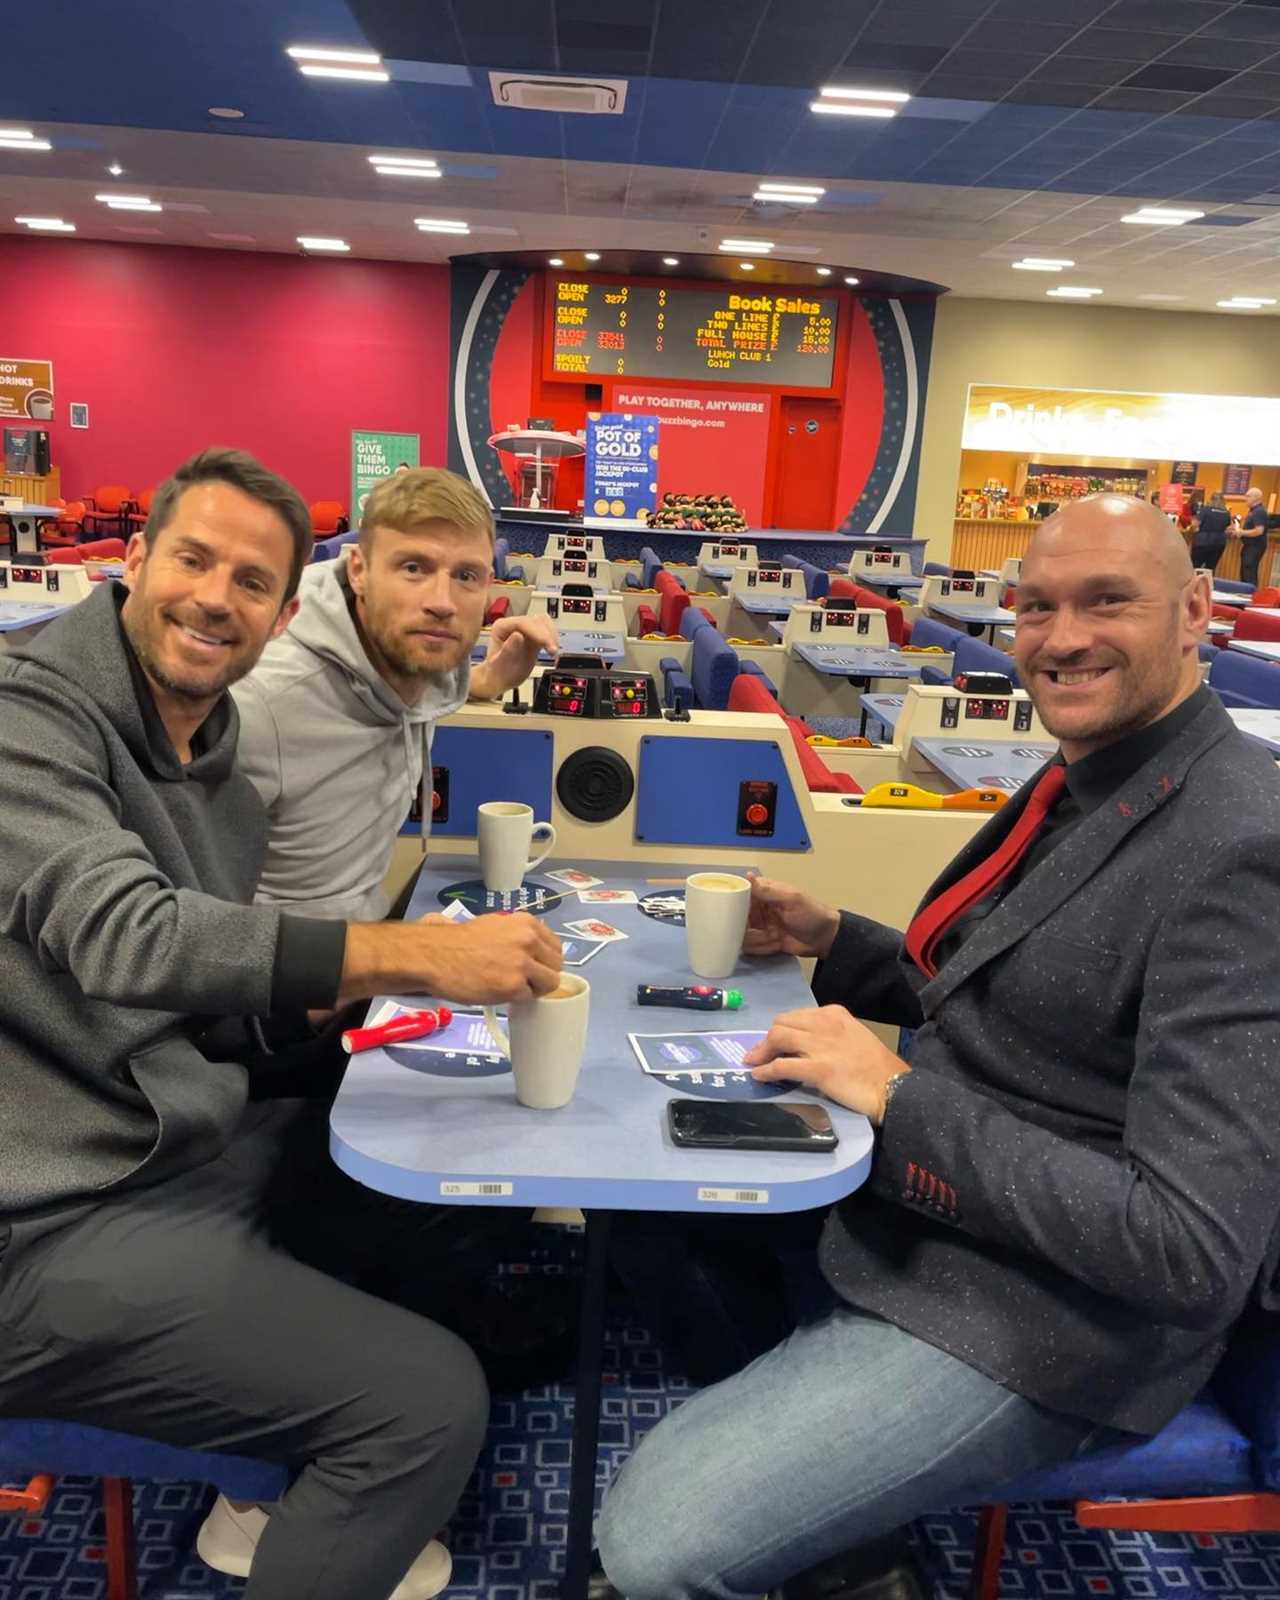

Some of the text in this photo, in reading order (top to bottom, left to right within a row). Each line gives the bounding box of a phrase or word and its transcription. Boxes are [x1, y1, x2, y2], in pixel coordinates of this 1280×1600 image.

[558, 283, 666, 298] CLOSE 0 0
[558, 292, 665, 306] OPEN 3277 0
[729, 295, 820, 314] Book Sales
[557, 306, 665, 321] CLOSE 0 0
[714, 311, 736, 320] ONE
[742, 312, 768, 323] LINE
[557, 316, 664, 330] OPEN 0 0
[706, 320, 728, 330] TWO
[735, 322, 768, 332] LINES
[803, 325, 831, 335] 10.00
[697, 328, 725, 339] FULL
[732, 331, 768, 341] HOUSE
[802, 335, 830, 345] 15.00
[695, 337, 726, 348] TOTAL
[733, 340, 767, 350] PRIZE
[708, 350, 736, 359] LUNCH
[739, 352, 762, 361] CLUB
[555, 362, 588, 373] TOTAL
[707, 359, 731, 369] Gold
[0, 376, 33, 387] DRINKS
[618, 394, 765, 413] PLAY TOGETHER, ANYWHERE
[596, 430, 641, 443] POT OF
[357, 443, 382, 454] GIVE
[595, 441, 642, 457] GOLD
[357, 454, 386, 464] THEM
[357, 464, 391, 475] BINGO
[632, 701, 641, 713] 0
